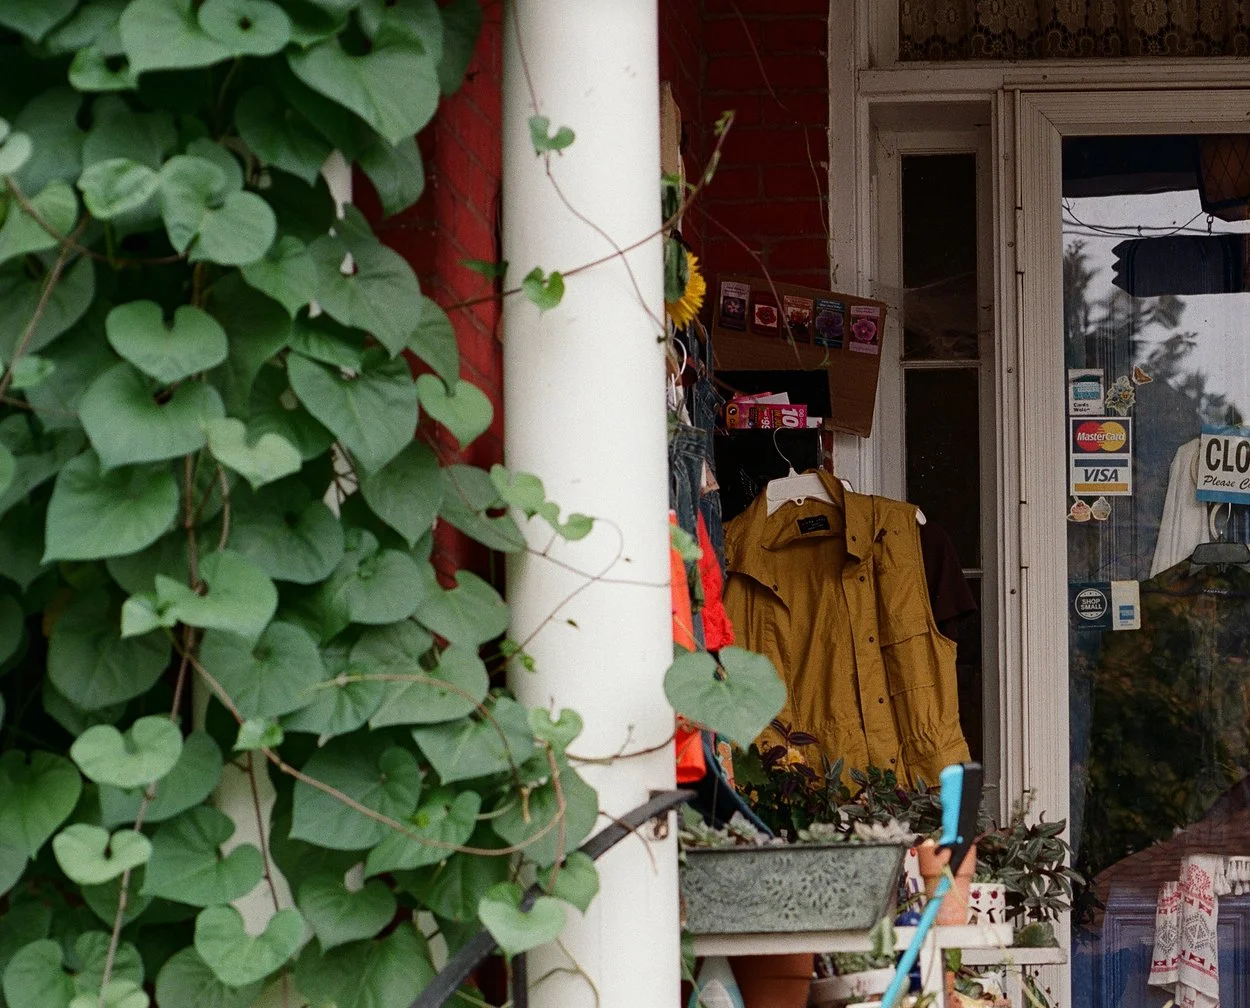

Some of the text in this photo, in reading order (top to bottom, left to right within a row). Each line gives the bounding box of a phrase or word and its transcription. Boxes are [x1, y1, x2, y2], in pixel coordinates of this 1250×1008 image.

[1076, 432, 1126, 441] MasterCard
[1083, 468, 1119, 482] VISA
[1202, 474, 1237, 488] Please
